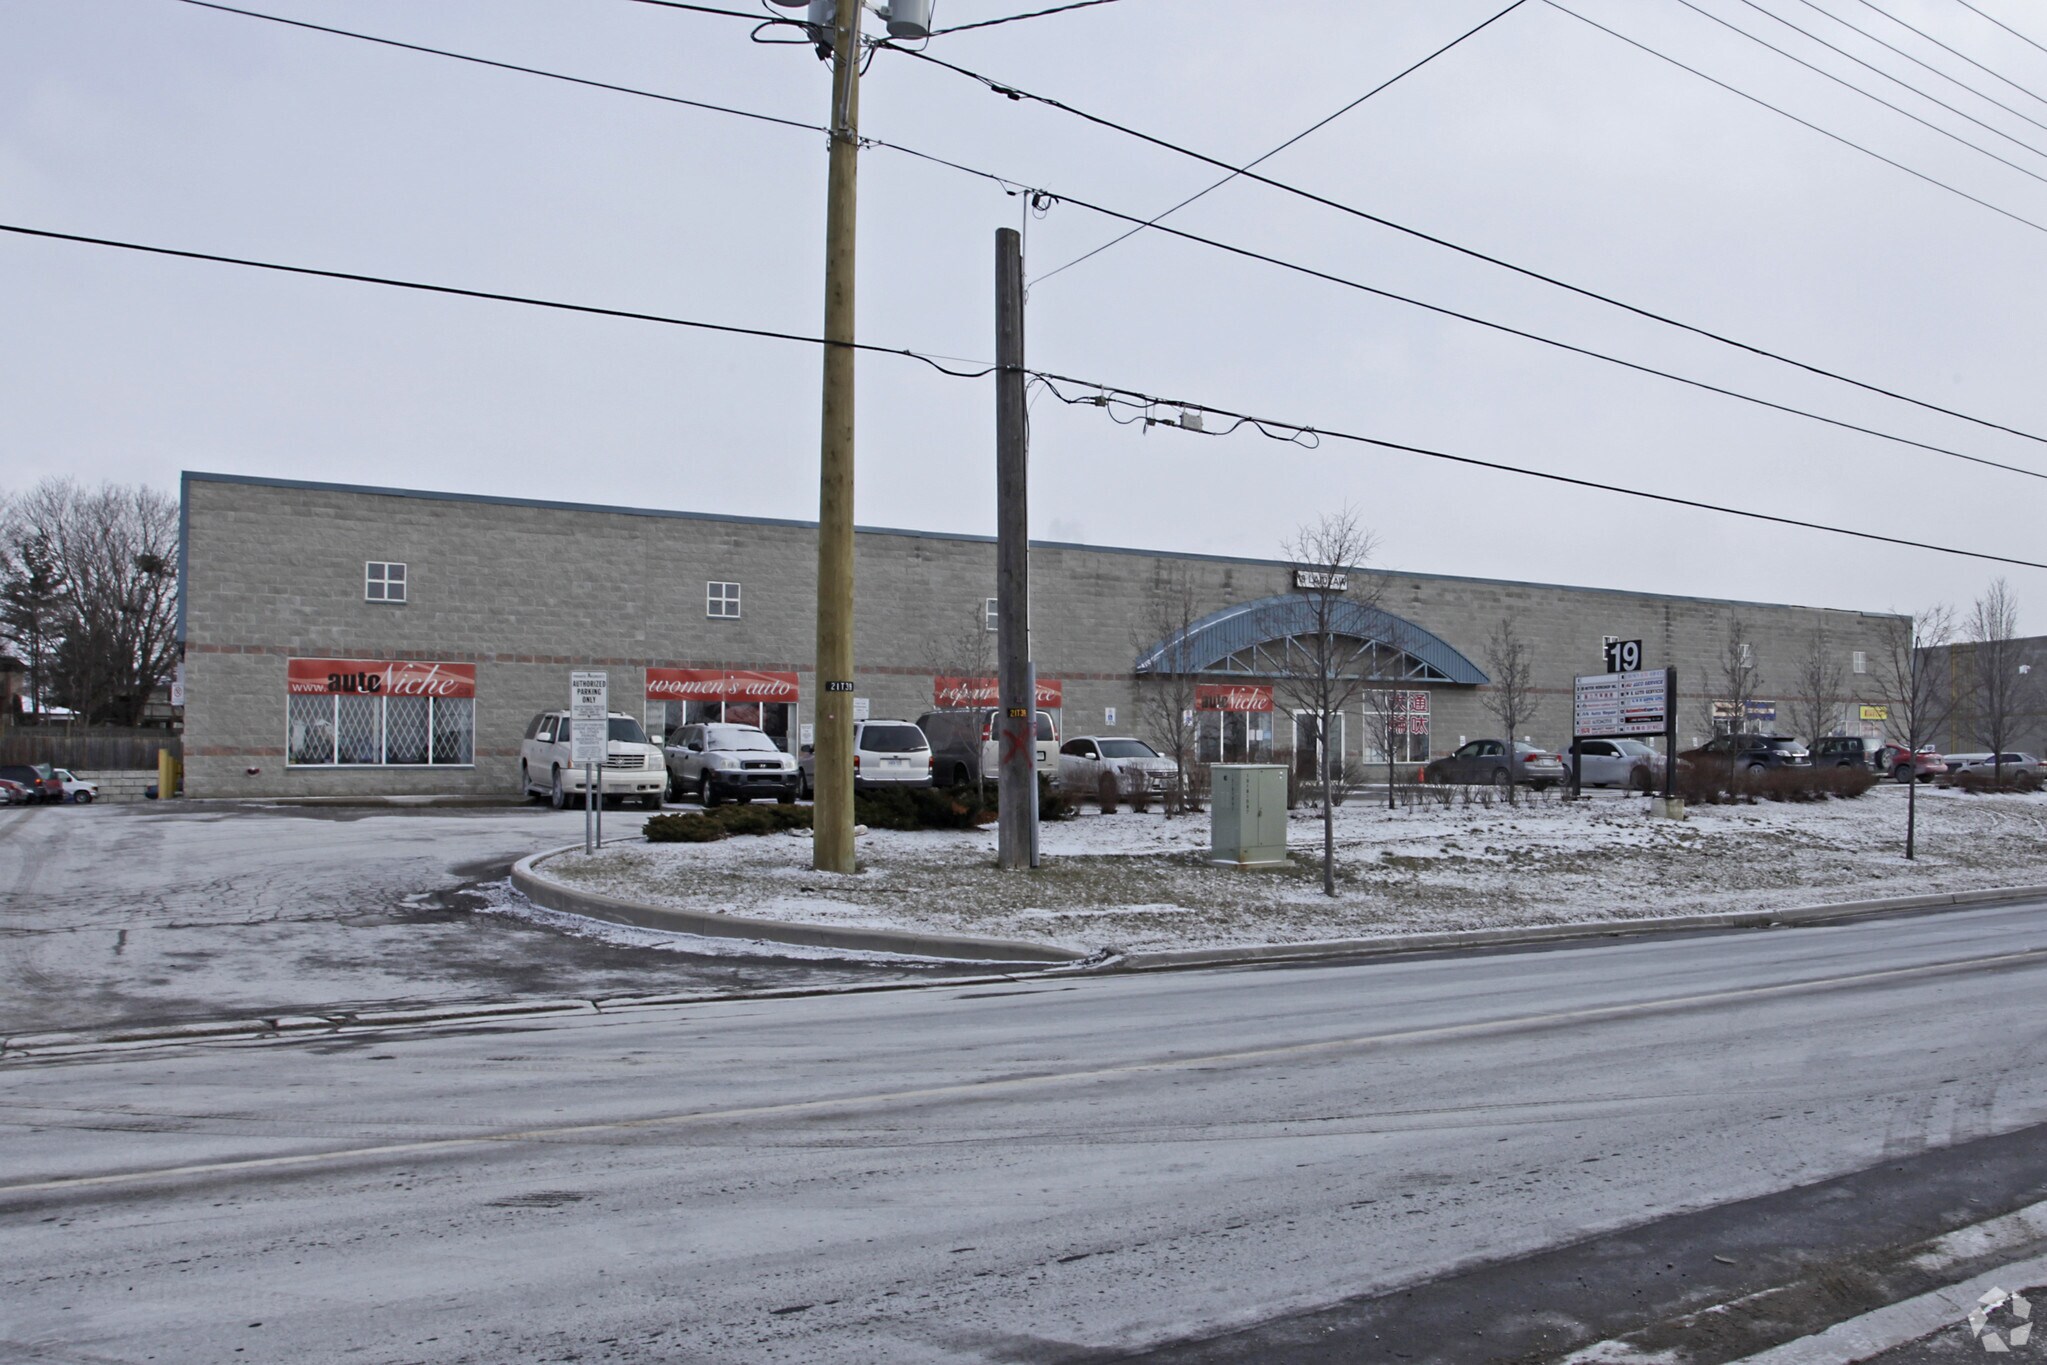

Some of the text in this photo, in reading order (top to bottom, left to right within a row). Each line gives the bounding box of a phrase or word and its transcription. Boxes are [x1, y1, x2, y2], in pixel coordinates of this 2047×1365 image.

[1308, 574, 1347, 587] LAIDAW
[1610, 641, 1639, 671] 19
[572, 680, 606, 688] AUTHORIZED
[648, 675, 792, 696] women's auto
